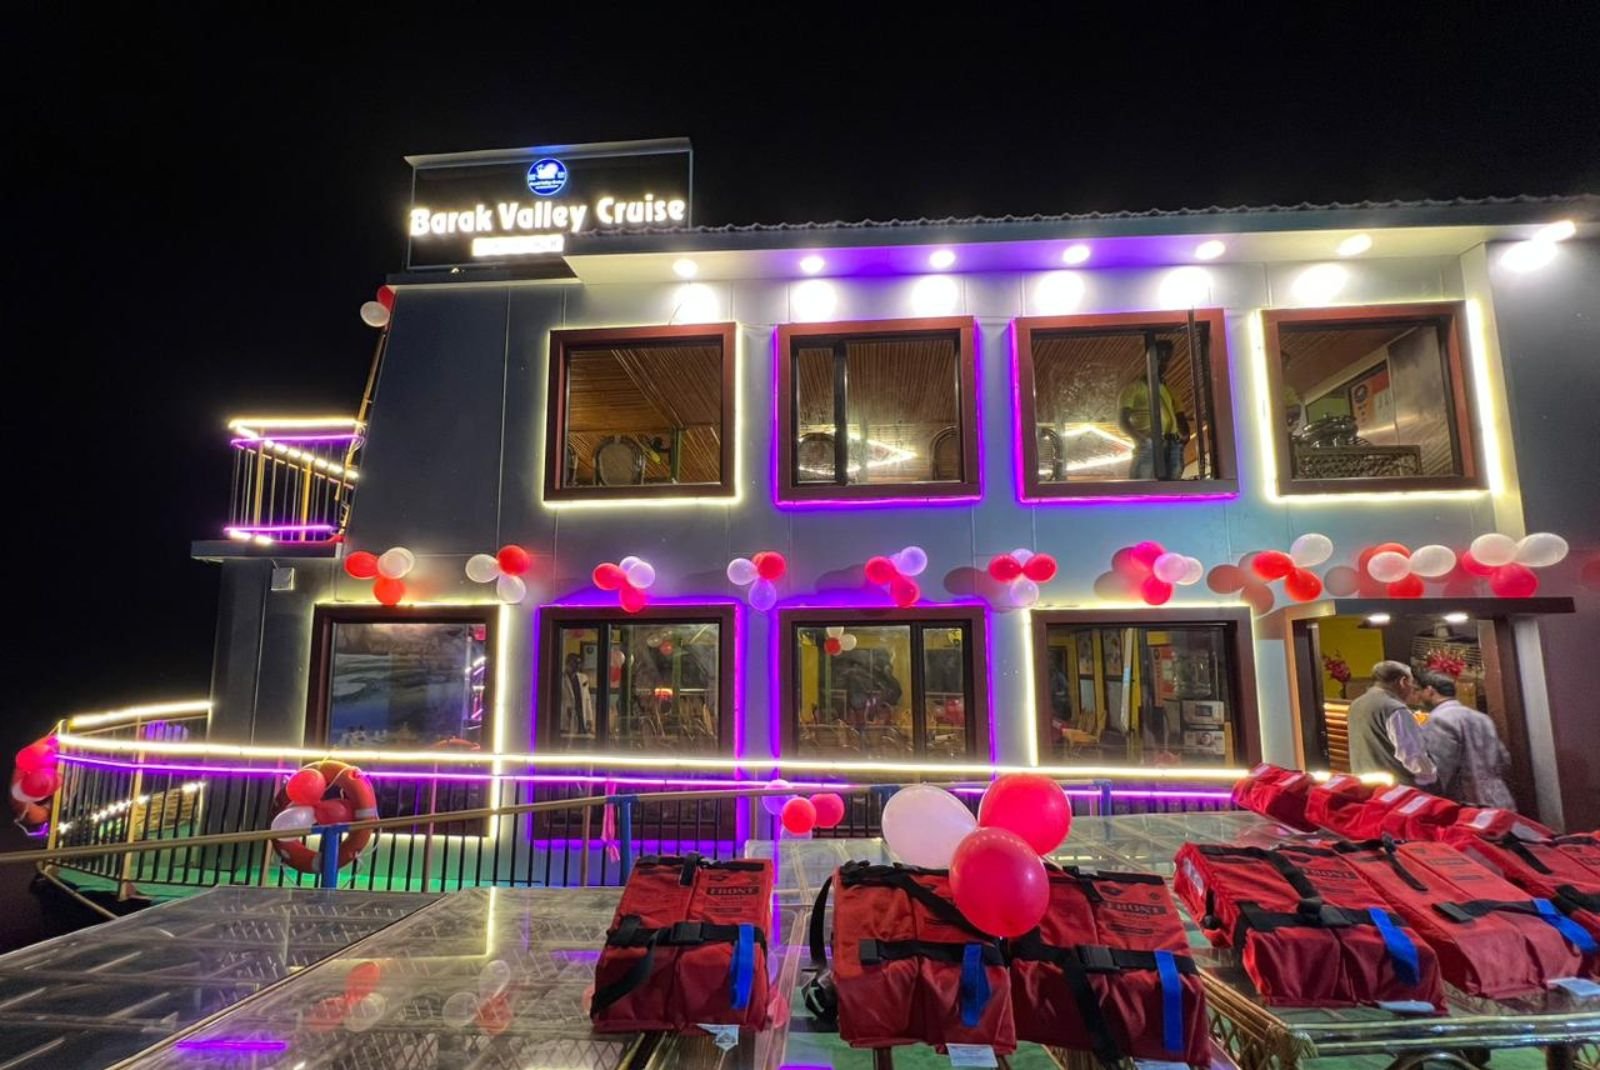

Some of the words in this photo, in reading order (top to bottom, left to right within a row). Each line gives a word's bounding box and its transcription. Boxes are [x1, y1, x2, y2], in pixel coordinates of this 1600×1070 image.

[409, 203, 493, 236] Barak
[498, 200, 587, 232] Valley
[597, 193, 686, 225] Cruise
[709, 887, 754, 896] FRONT
